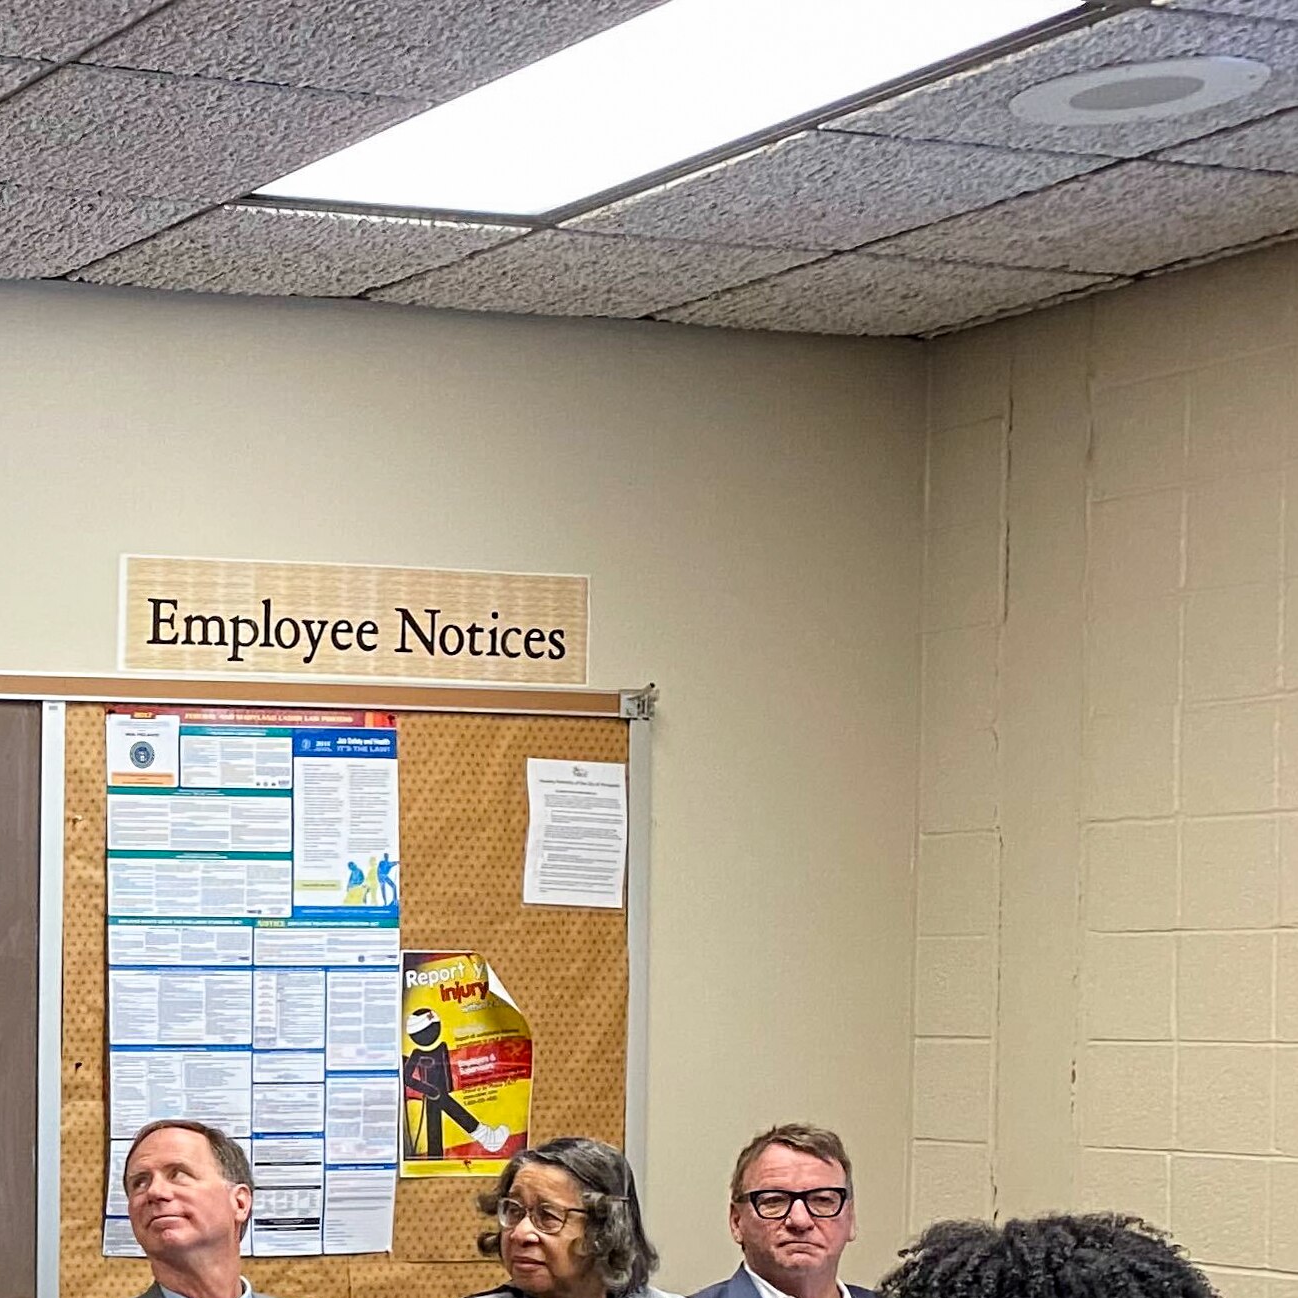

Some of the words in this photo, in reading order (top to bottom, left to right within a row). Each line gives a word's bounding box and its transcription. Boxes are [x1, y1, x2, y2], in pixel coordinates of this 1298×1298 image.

[146, 598, 379, 664] Employee
[394, 607, 567, 661] Notices
[405, 961, 465, 988] Report
[439, 980, 489, 1004] injury
